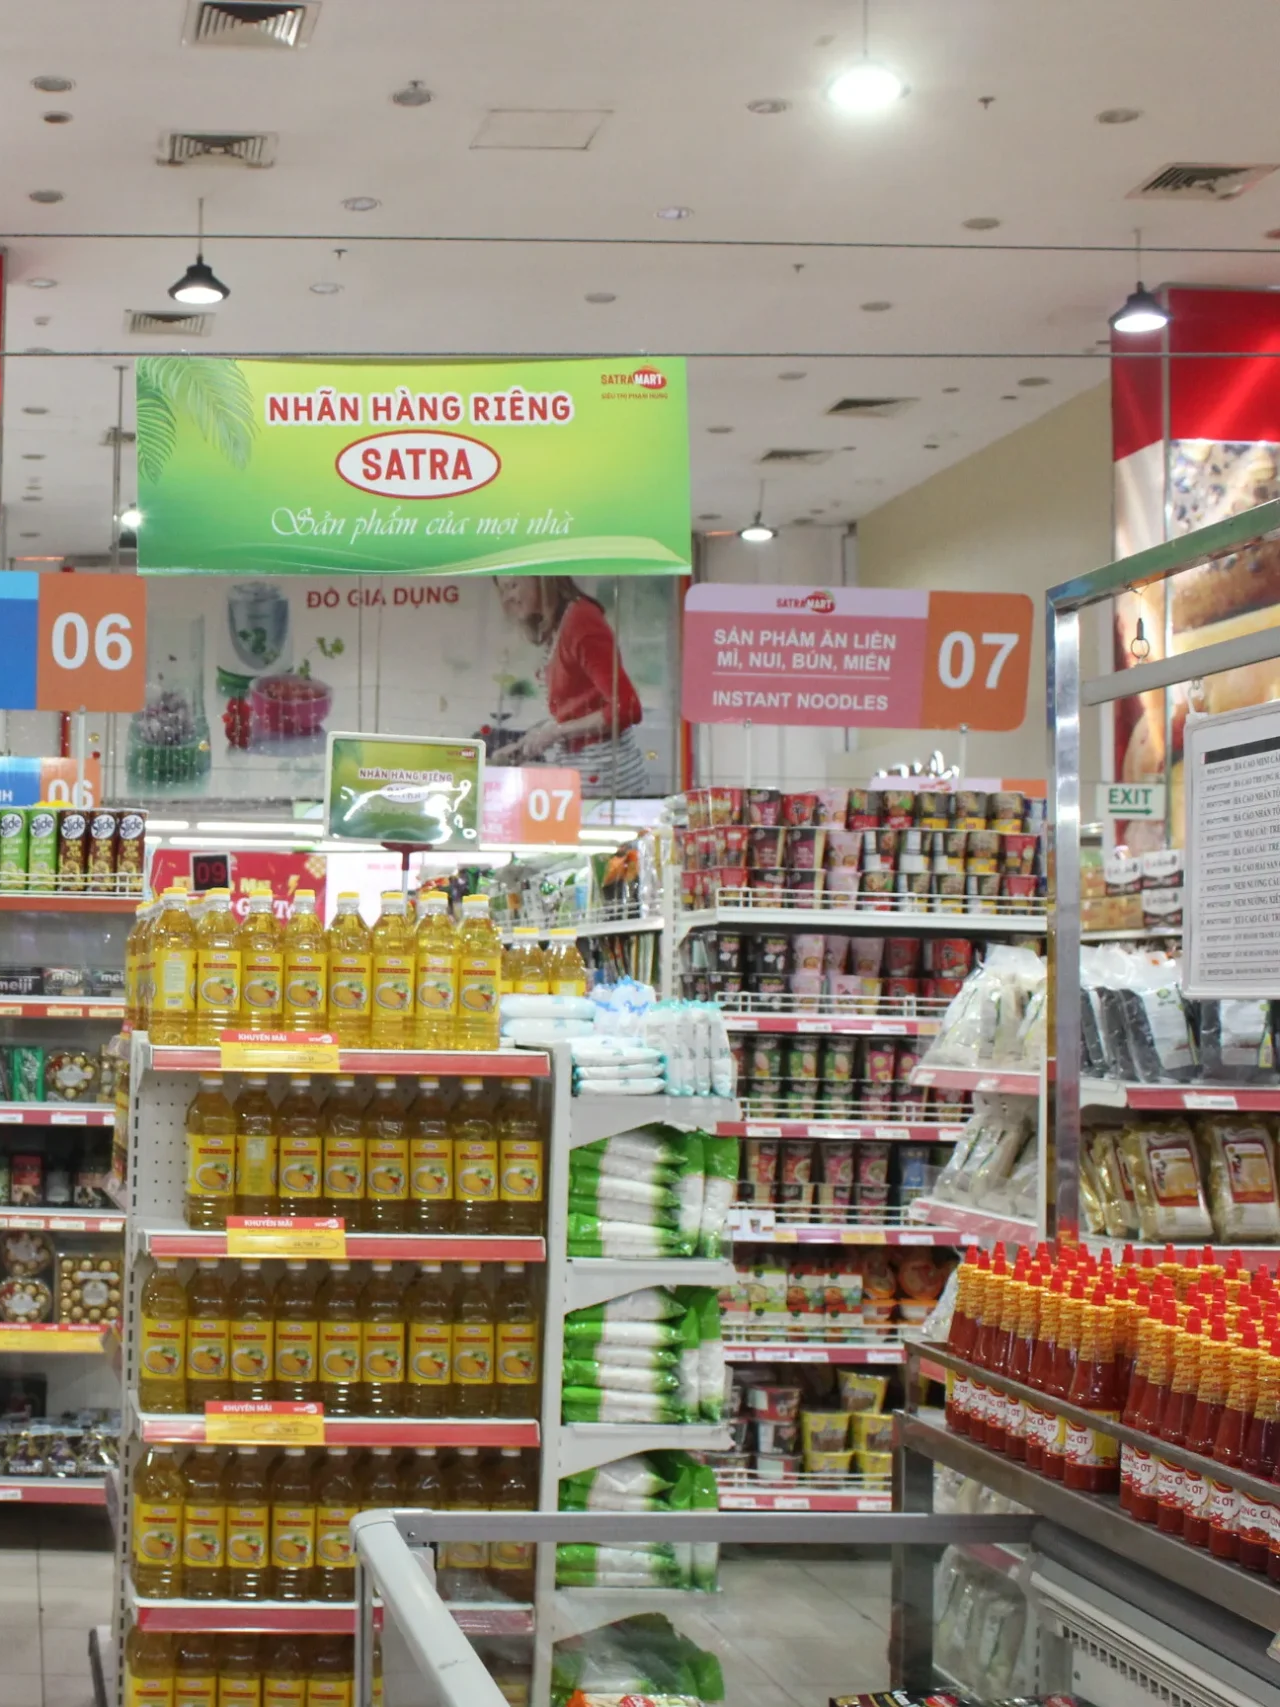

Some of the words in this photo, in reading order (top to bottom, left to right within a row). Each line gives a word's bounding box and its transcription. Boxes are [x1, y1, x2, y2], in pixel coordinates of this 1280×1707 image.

[601, 374, 662, 385] SATRAMART
[269, 389, 363, 421] NHÃN
[373, 388, 461, 421] HÀNG
[474, 388, 572, 421] RIÊNG
[362, 448, 473, 480] SATRA
[271, 506, 344, 536] Sản
[349, 505, 417, 544] phẩm
[425, 511, 470, 536] của
[476, 513, 521, 541] mọi
[526, 510, 574, 536] nhà
[347, 587, 386, 607] GIA
[393, 584, 460, 609] DỤNG
[51, 612, 133, 670] 06
[820, 626, 848, 649] ĂN
[749, 652, 786, 671] NUI,
[937, 629, 1019, 690] 07
[712, 689, 792, 709] INSTANT
[797, 690, 889, 712] NOODLES
[391, 769, 420, 781] HÀNG
[422, 770, 453, 782] RIÊNG
[47, 779, 94, 808] 06
[528, 788, 574, 823] 07
[1108, 787, 1153, 806] EXIT
